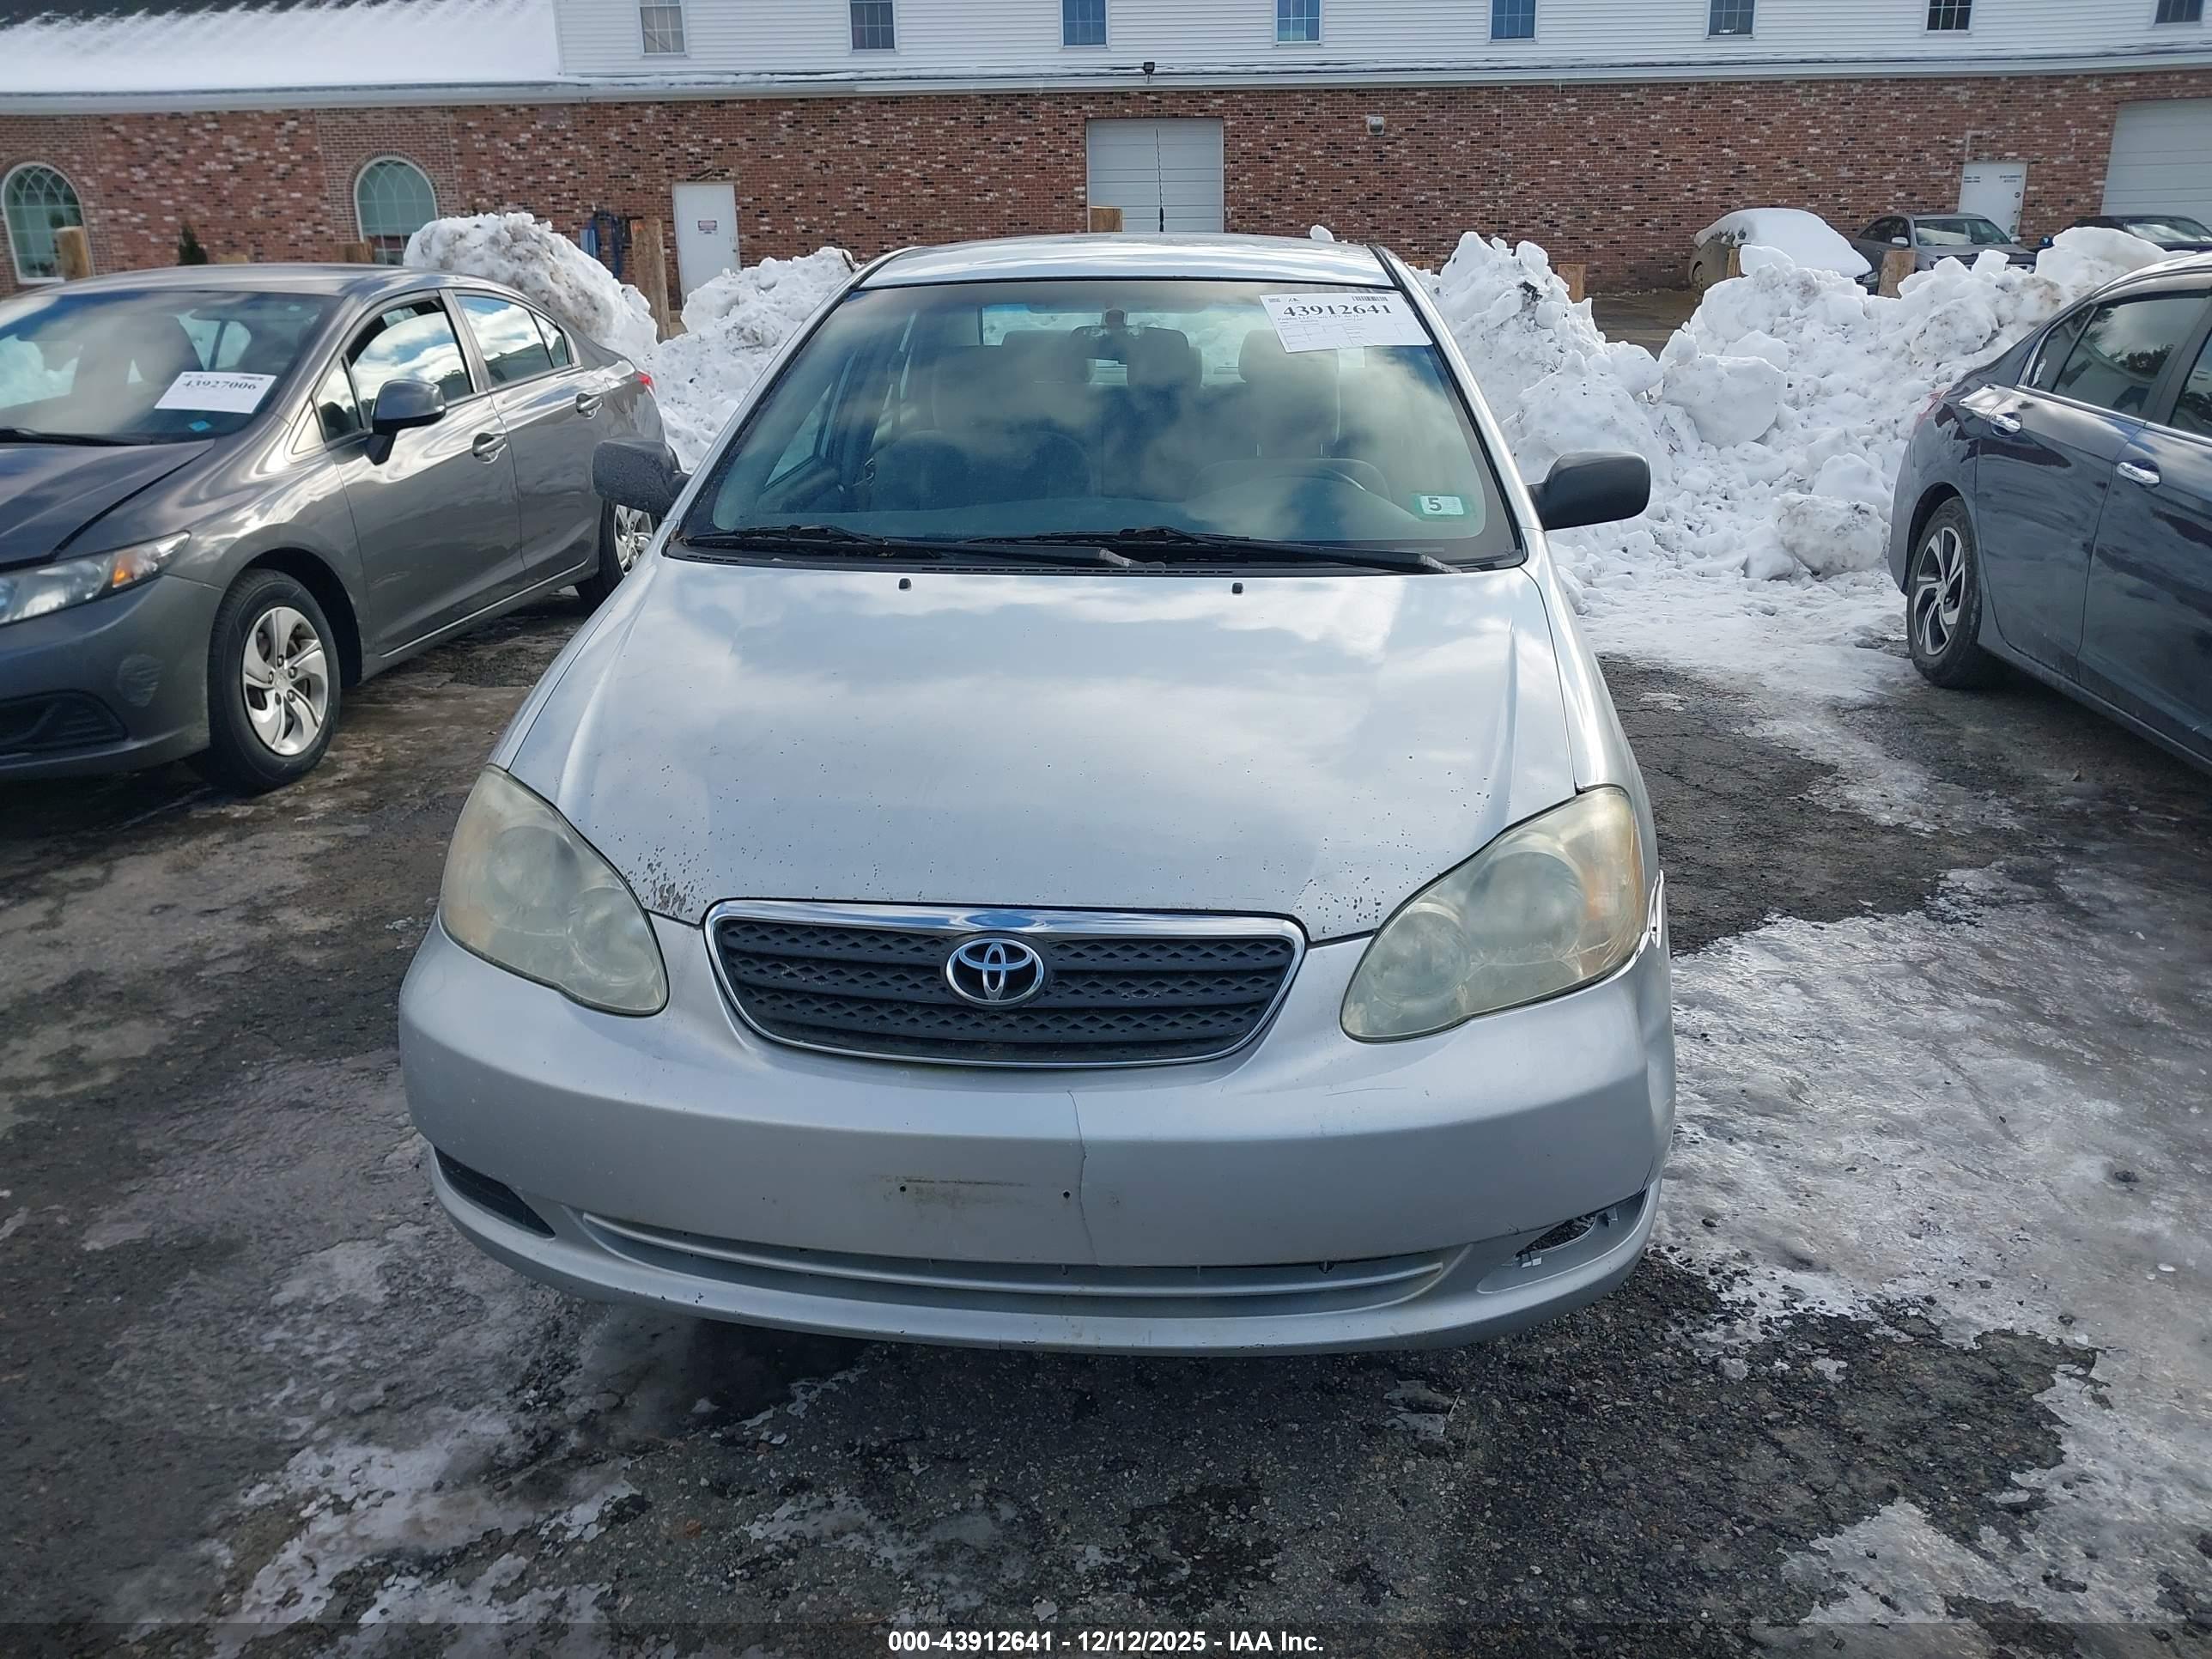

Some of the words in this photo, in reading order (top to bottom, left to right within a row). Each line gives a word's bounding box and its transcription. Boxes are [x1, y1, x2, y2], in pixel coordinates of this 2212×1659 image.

[1283, 303, 1393, 317] 43912641
[182, 380, 257, 391] 43927006
[1427, 497, 1443, 512] 5
